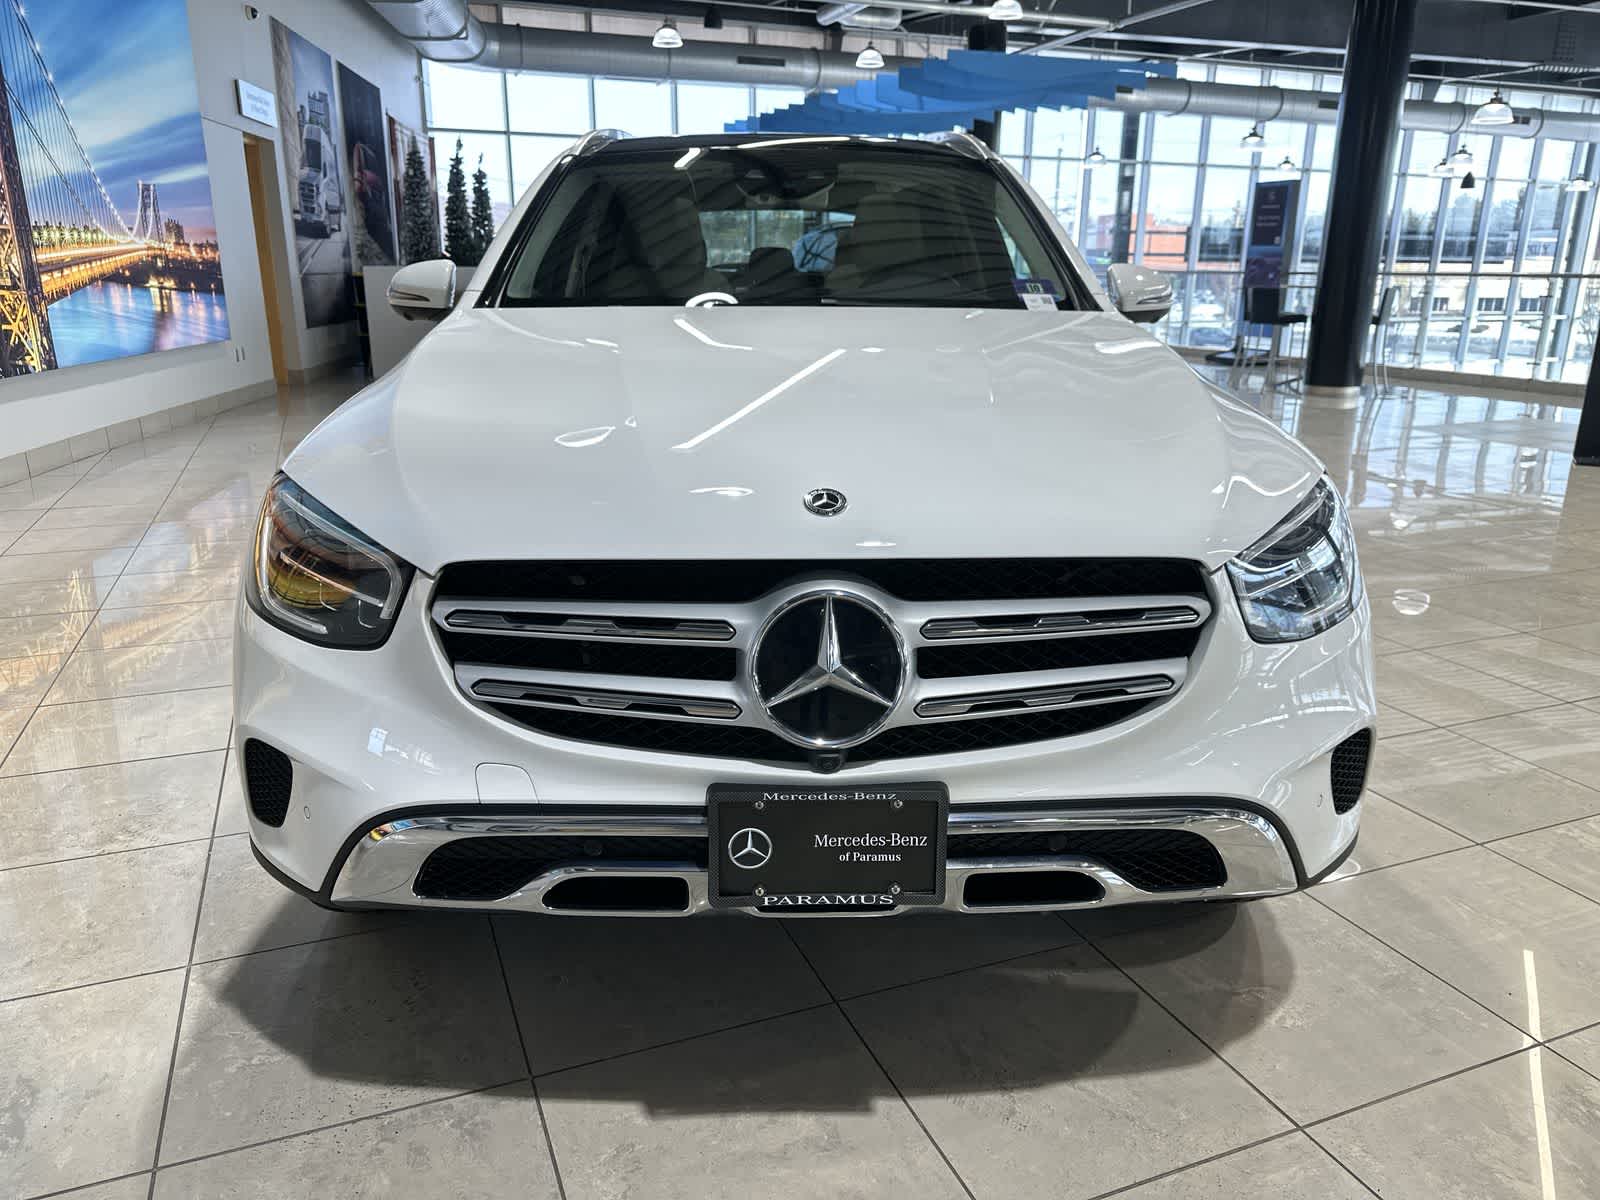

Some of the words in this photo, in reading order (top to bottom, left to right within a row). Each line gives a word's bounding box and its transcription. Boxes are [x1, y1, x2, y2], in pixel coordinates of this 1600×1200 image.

[763, 792, 897, 801] Mercedes-Benz
[814, 833, 928, 848] Mercedes-Benz
[839, 852, 851, 862] of
[852, 852, 902, 862] Paramus
[763, 895, 895, 906] PARAMUS
